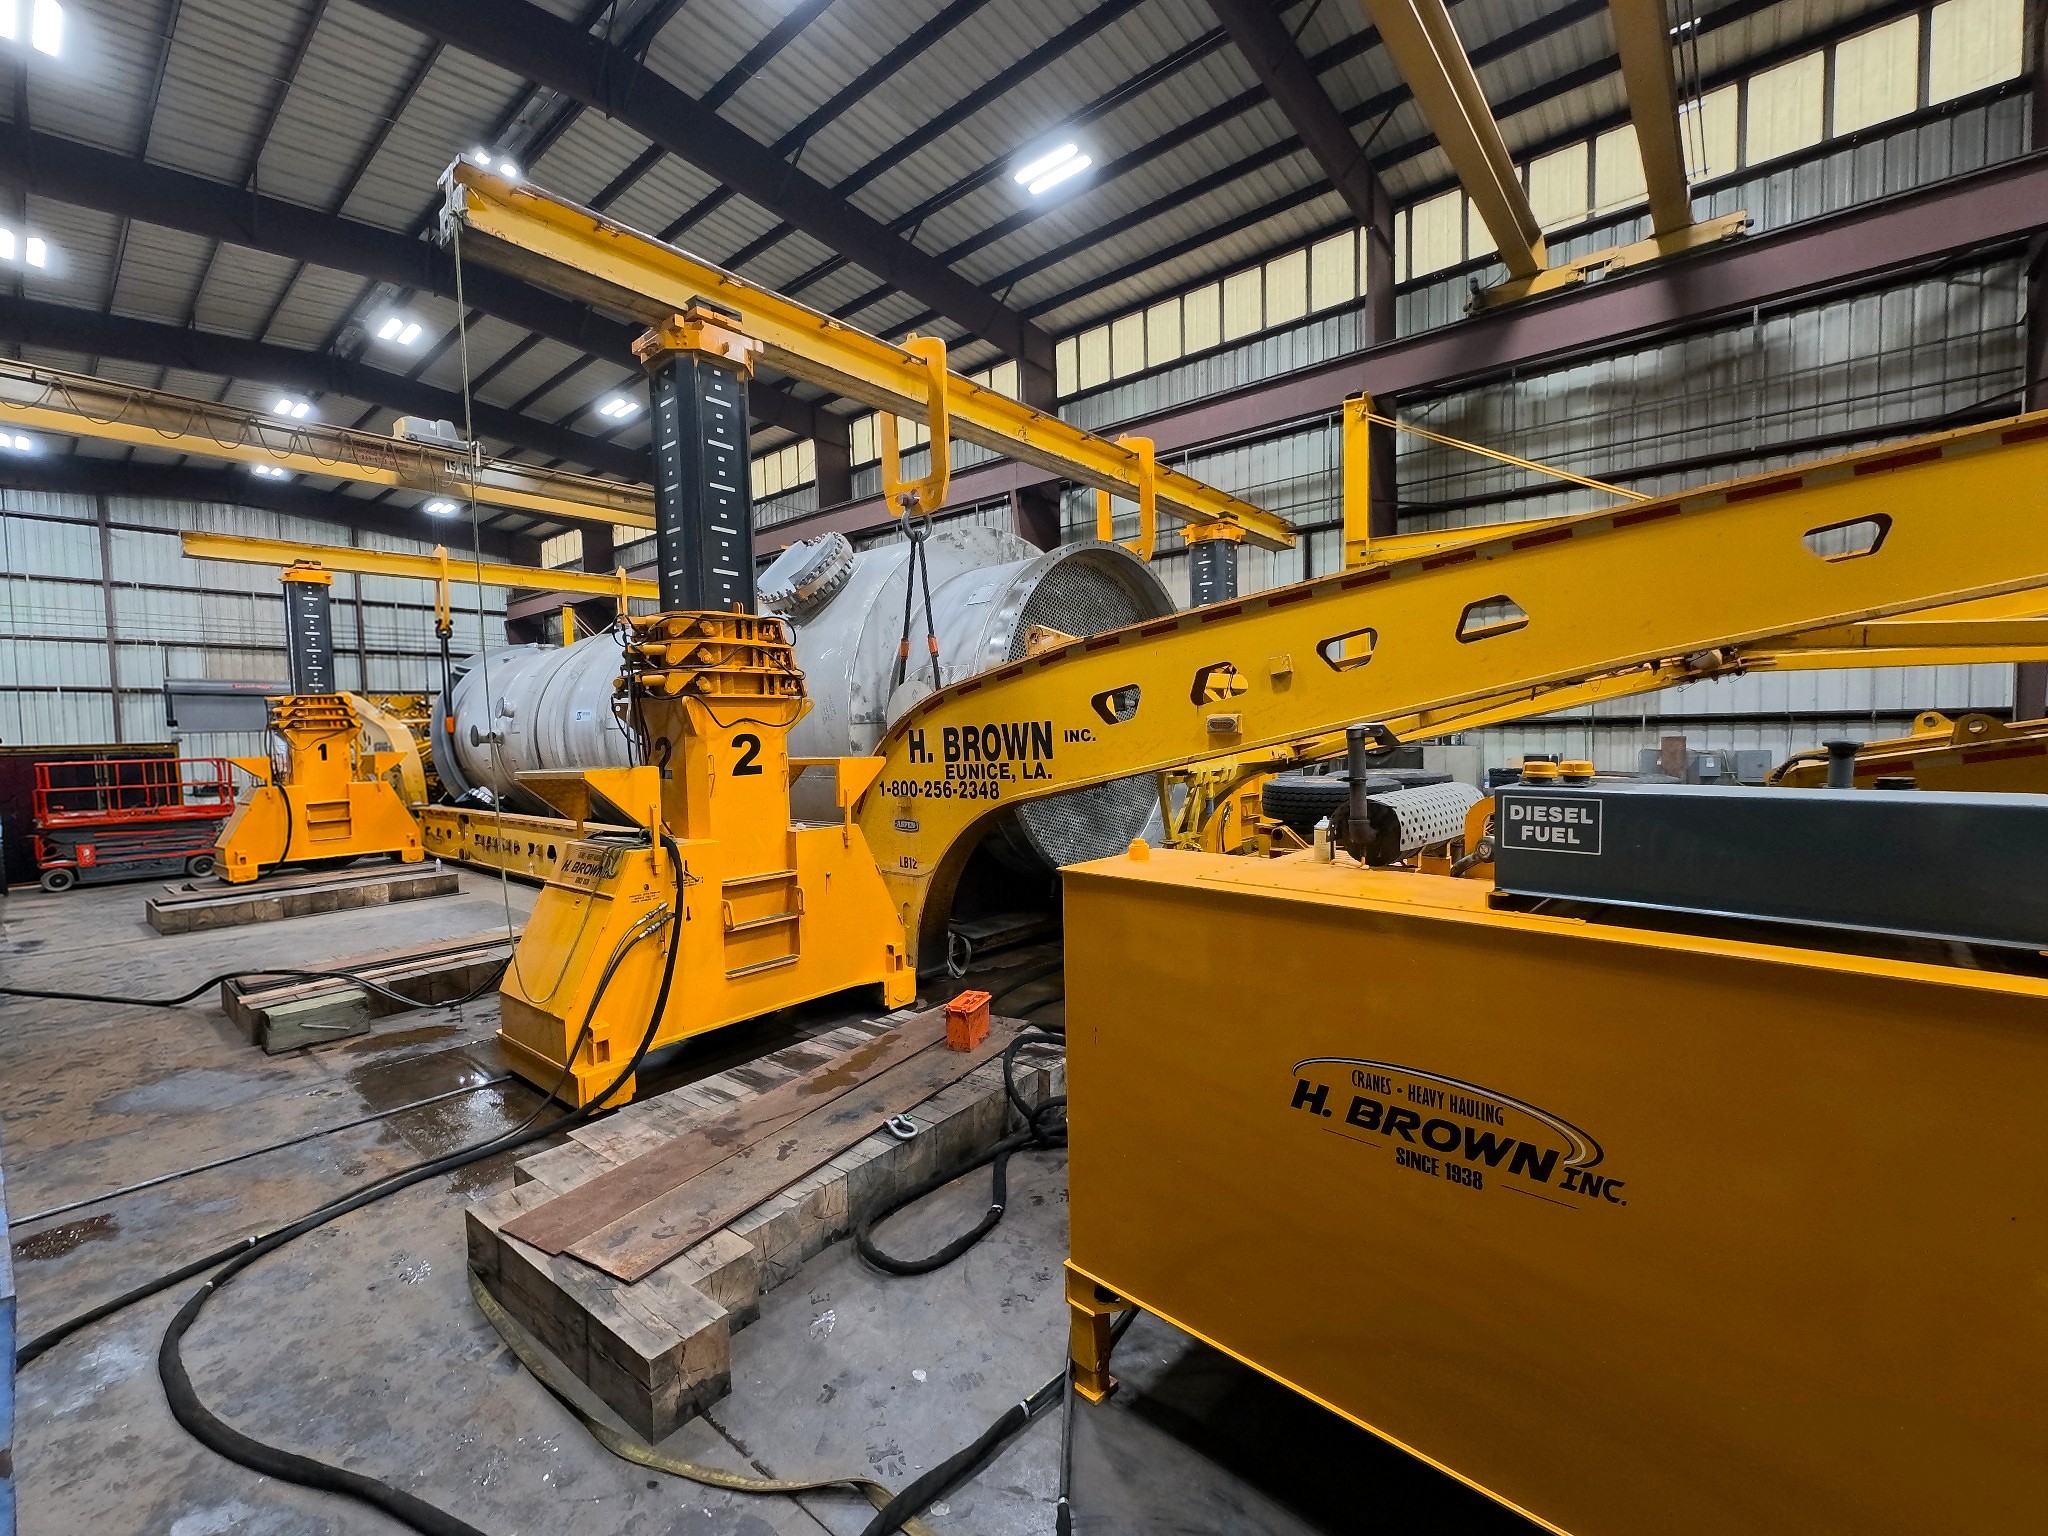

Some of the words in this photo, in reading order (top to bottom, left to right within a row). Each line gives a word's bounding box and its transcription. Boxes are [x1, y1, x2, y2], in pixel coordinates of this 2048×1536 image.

[317, 743, 328, 761] 1
[731, 733, 763, 776] 2
[908, 728, 933, 763] H.
[942, 720, 1054, 763] BROWN
[1063, 728, 1097, 743] INC.
[945, 762, 1016, 783] EUNICE,
[1022, 763, 1053, 780] LA.
[879, 780, 1000, 800] 1-800-256-2348
[1509, 804, 1594, 825] DIESEL
[1521, 825, 1581, 845] FUEL
[1351, 1069, 1392, 1096] CRANES
[1407, 1083, 1445, 1110] HEAVY
[1449, 1094, 1505, 1127] HAULING
[1290, 1078, 1333, 1119] H.
[1344, 1095, 1561, 1184] BROWN
[1557, 1166, 1628, 1207] INC.
[1395, 1146, 1440, 1178] SINCE
[1444, 1161, 1484, 1191] 1938
